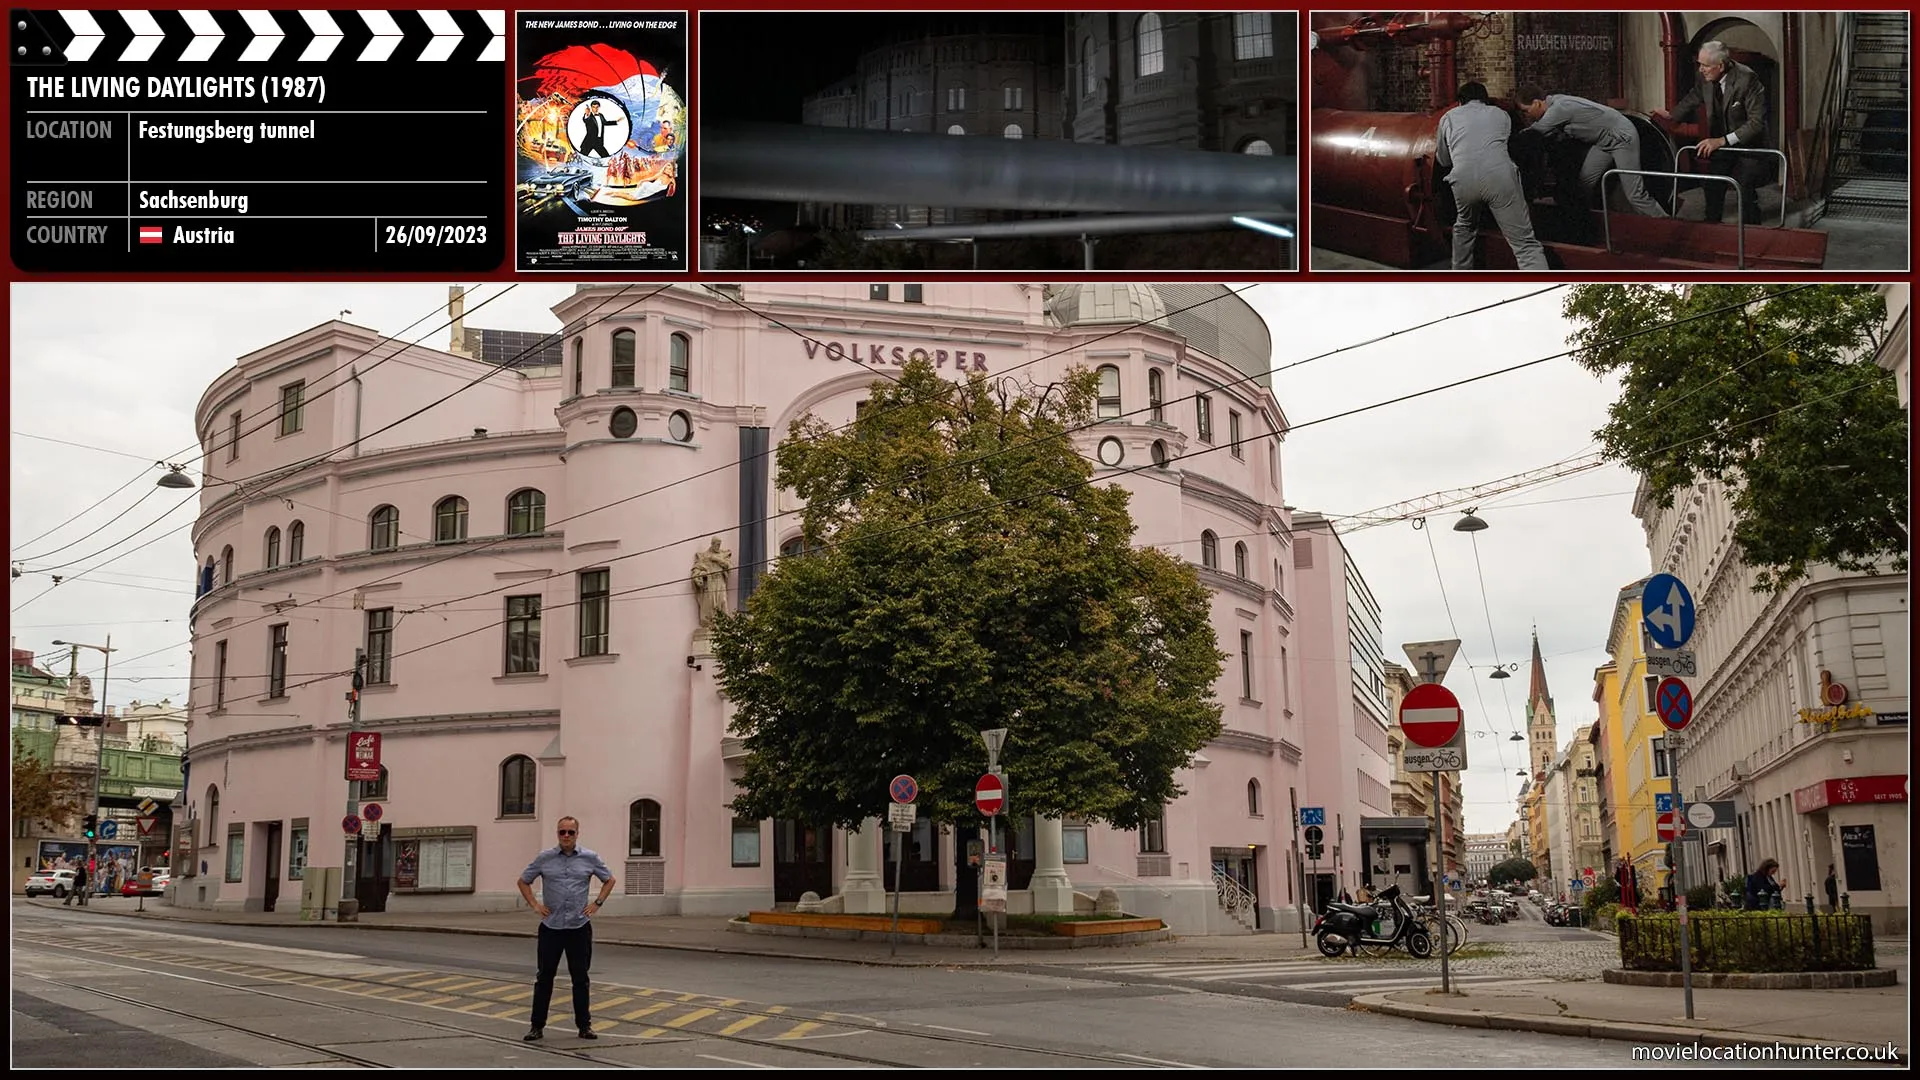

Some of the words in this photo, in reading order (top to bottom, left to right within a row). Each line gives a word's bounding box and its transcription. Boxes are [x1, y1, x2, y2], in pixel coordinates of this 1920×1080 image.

[526, 20, 538, 29] THE
[538, 20, 555, 29] NEW
[555, 20, 578, 29] JAMES
[609, 20, 632, 29] LIVING
[633, 20, 645, 29] ON
[645, 20, 658, 29] THE
[658, 20, 678, 29] EDGE
[1517, 34, 1567, 50] RAUCHEN
[1569, 35, 1614, 51] VERBOTEN
[558, 232, 574, 245] THE
[575, 232, 602, 245] LIVING
[604, 232, 646, 245] DAYLIGHTS
[803, 339, 988, 371] VOLKSOPER
